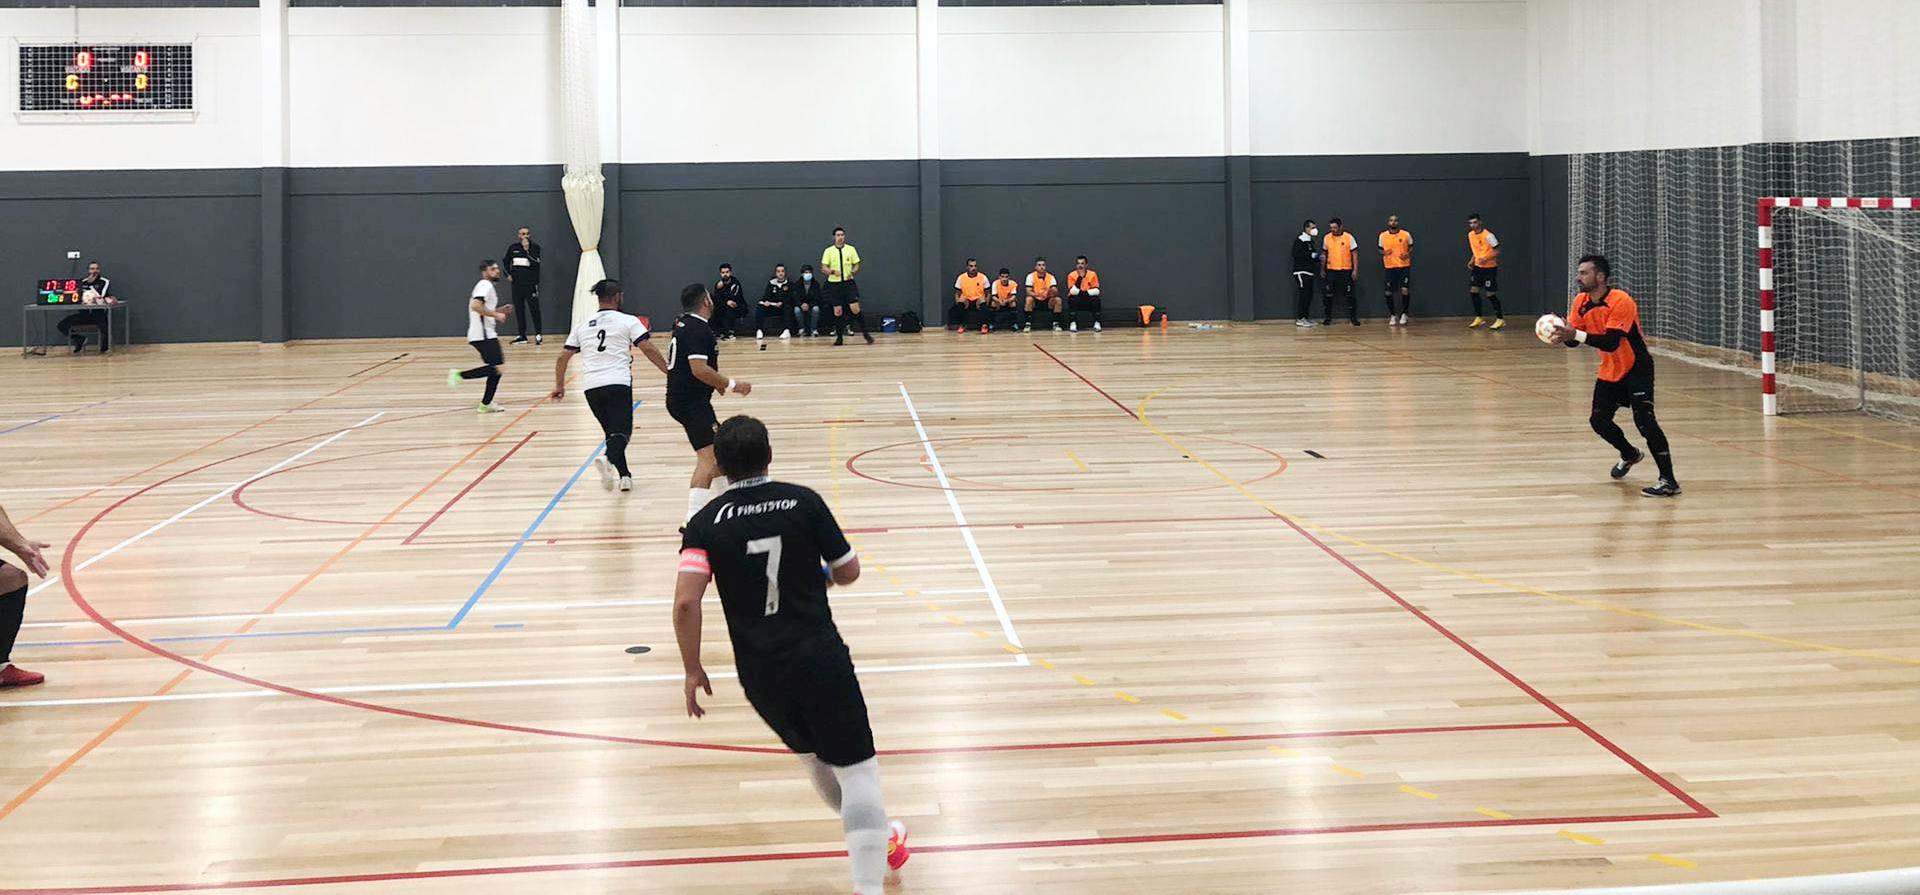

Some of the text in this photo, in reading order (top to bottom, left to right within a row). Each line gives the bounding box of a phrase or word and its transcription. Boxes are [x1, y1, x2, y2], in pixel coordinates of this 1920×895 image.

[596, 329, 607, 352] 2
[737, 498, 798, 517] FIRSTSTOP
[745, 535, 783, 617] 7
